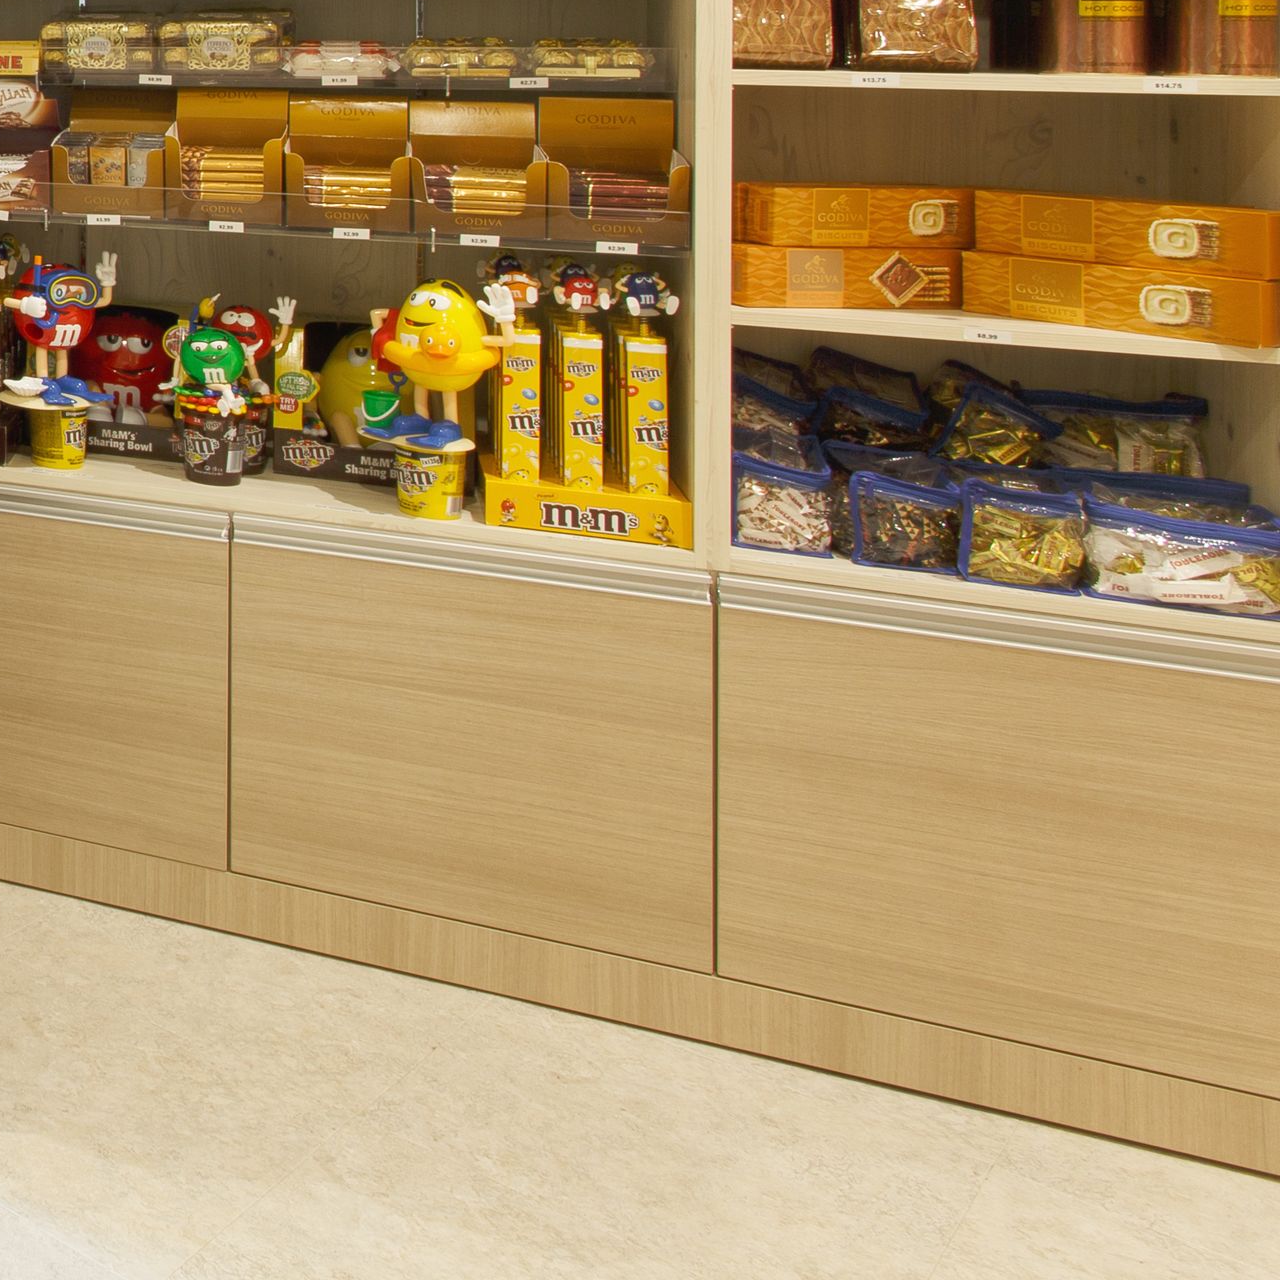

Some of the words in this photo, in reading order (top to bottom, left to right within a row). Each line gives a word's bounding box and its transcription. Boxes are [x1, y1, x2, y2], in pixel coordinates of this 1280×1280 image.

[861, 76, 887, 84] $13.75
[1155, 82, 1182, 90] $14.75
[574, 113, 637, 126] GODIVA
[84, 194, 130, 208] GODIVA
[200, 203, 244, 215] GODIVA
[818, 211, 864, 224] GODIVA
[1016, 304, 1077, 318] BISCUITS
[101, 428, 136, 439] M&M's
[345, 464, 387, 478] Sharing
[540, 502, 638, 536] m&m's
